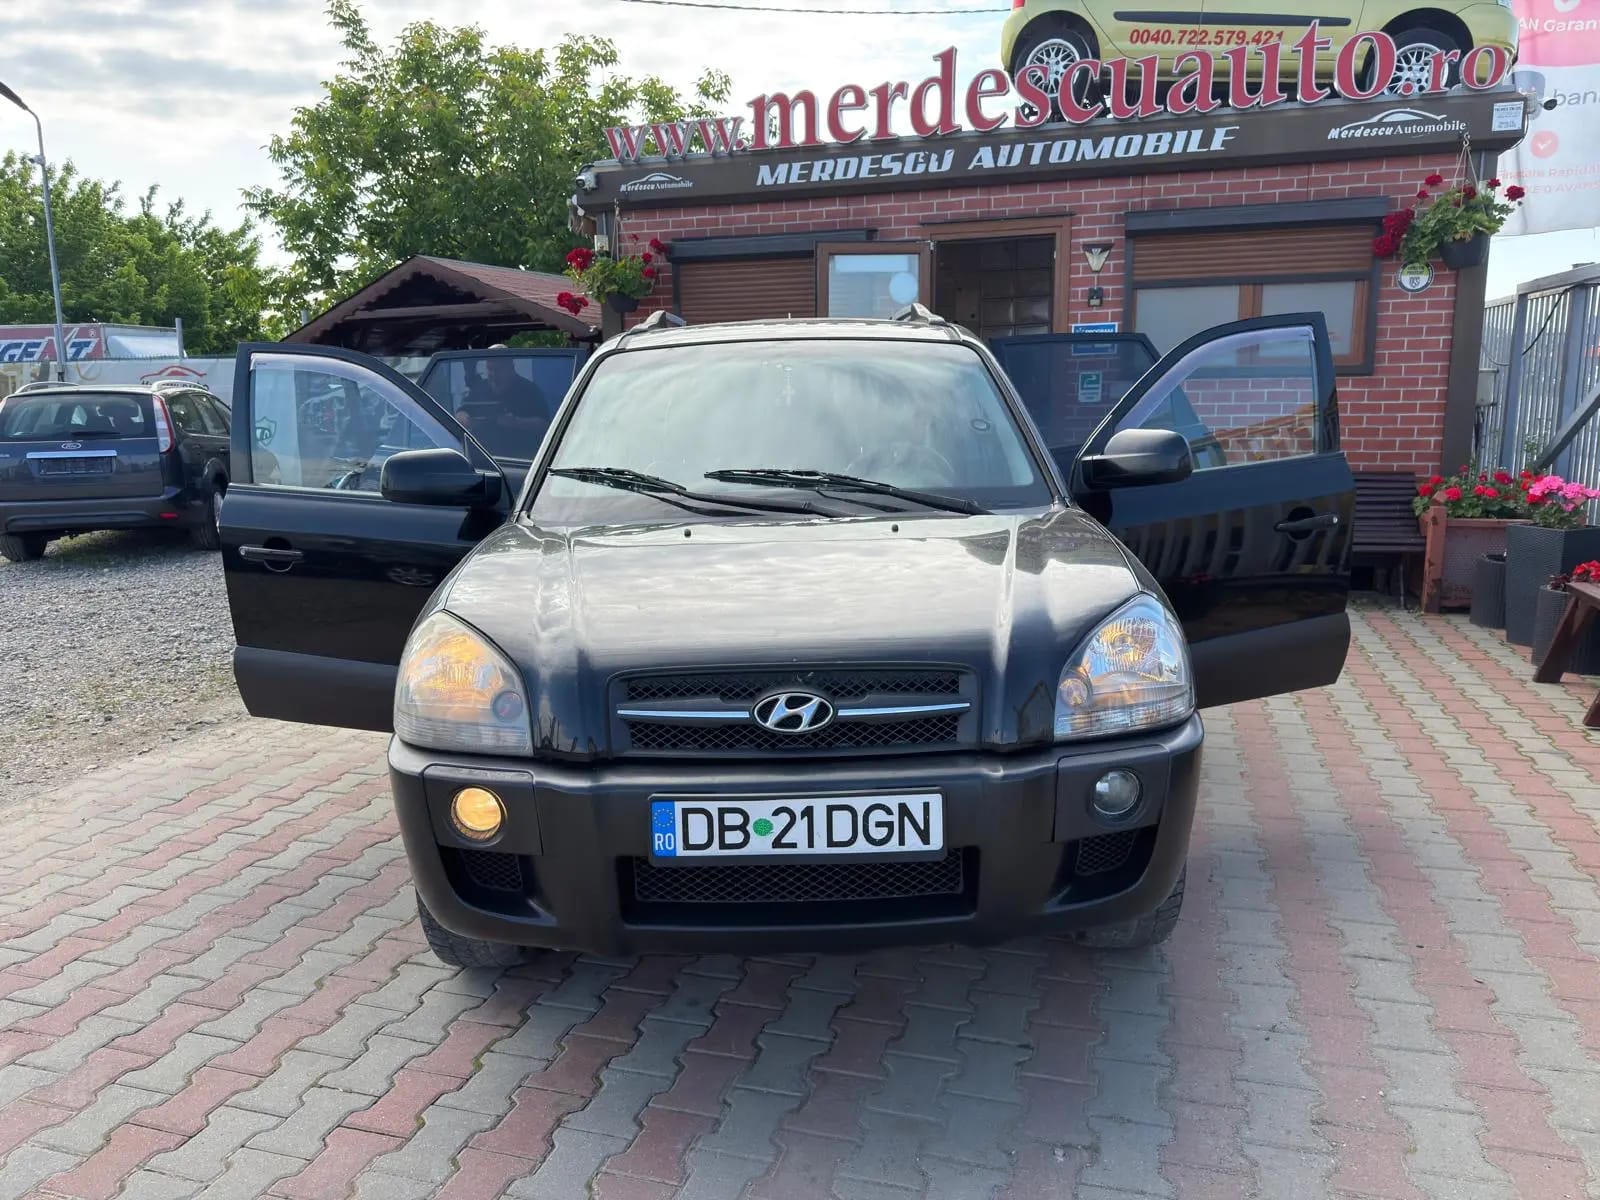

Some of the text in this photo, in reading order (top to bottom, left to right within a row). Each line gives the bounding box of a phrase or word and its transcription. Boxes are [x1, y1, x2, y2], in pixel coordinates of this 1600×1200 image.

[1129, 28, 1285, 46] 0040.722.579.421
[603, 19, 1510, 162] www.merdescuauto.ro
[1553, 88, 1600, 106] ban
[755, 126, 1240, 187] MERDESCU AUTOMOBILE
[655, 833, 674, 850] RO
[681, 802, 930, 851] DB 21 DGN
